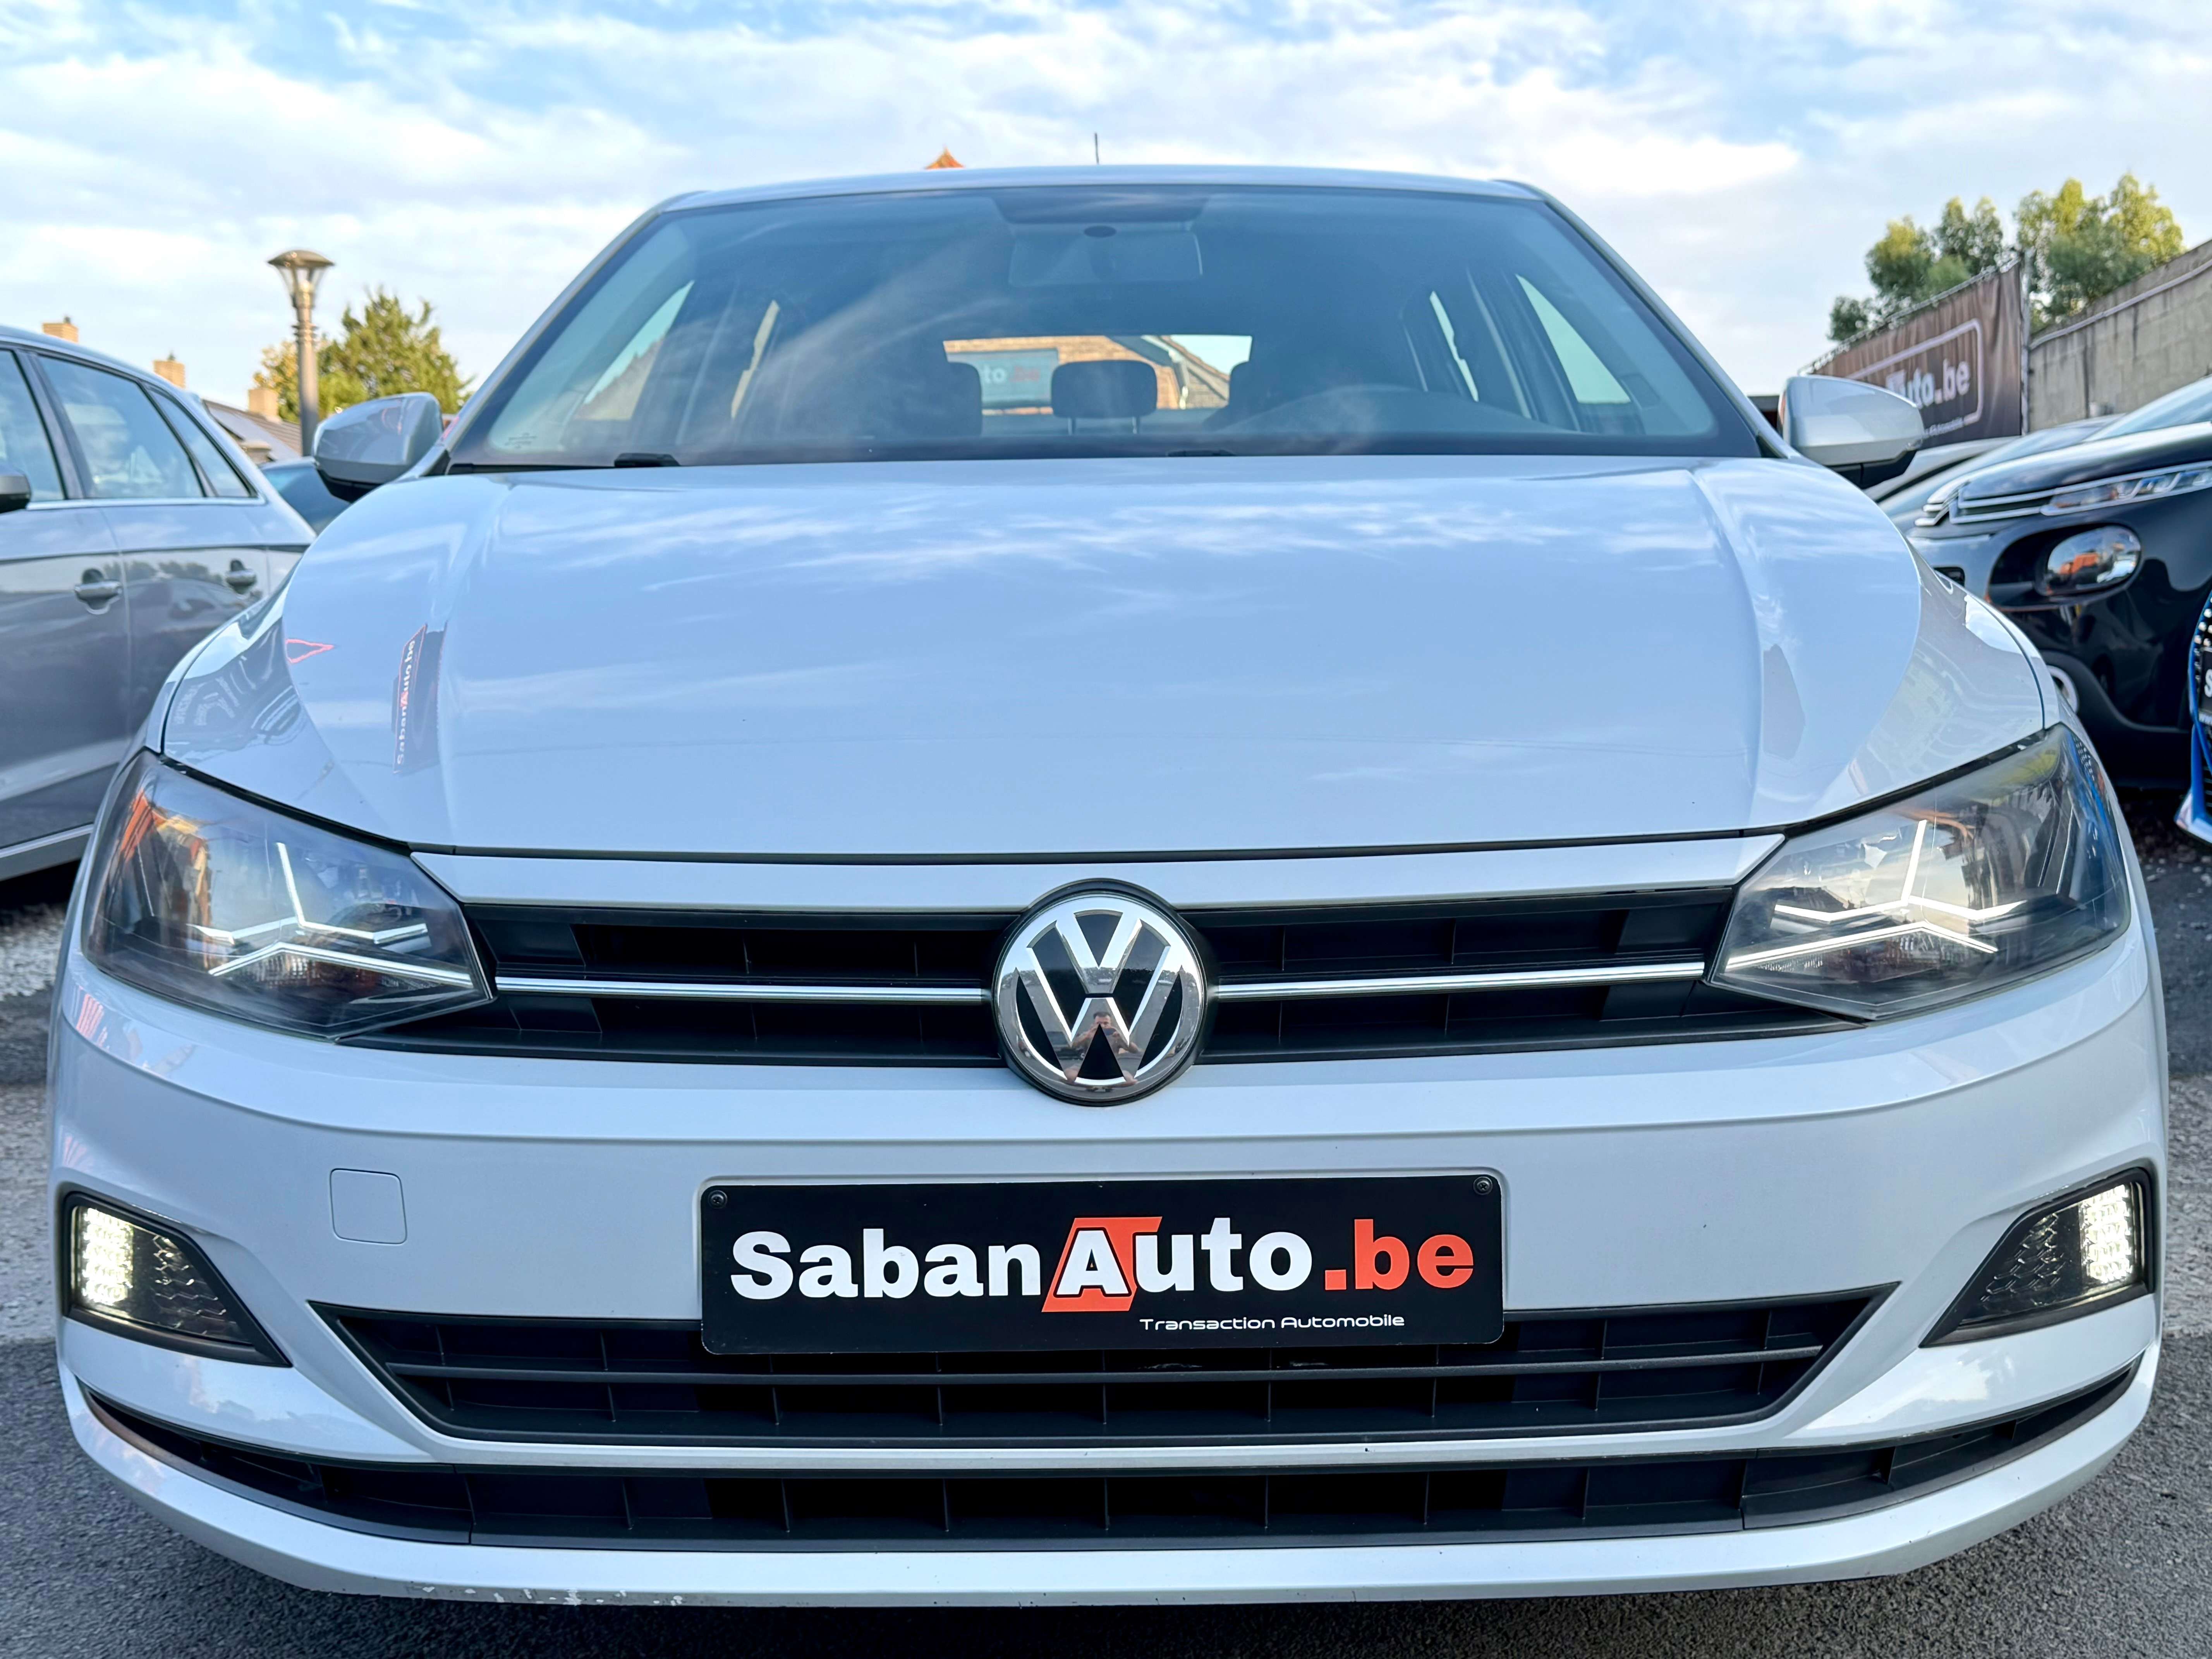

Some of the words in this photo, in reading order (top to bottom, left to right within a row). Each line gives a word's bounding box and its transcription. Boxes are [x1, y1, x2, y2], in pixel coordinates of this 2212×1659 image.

[730, 1216, 1474, 1312] SabanAuto.be
[1139, 1317, 1276, 1331] Transaction
[1281, 1314, 1405, 1329] Automobile
